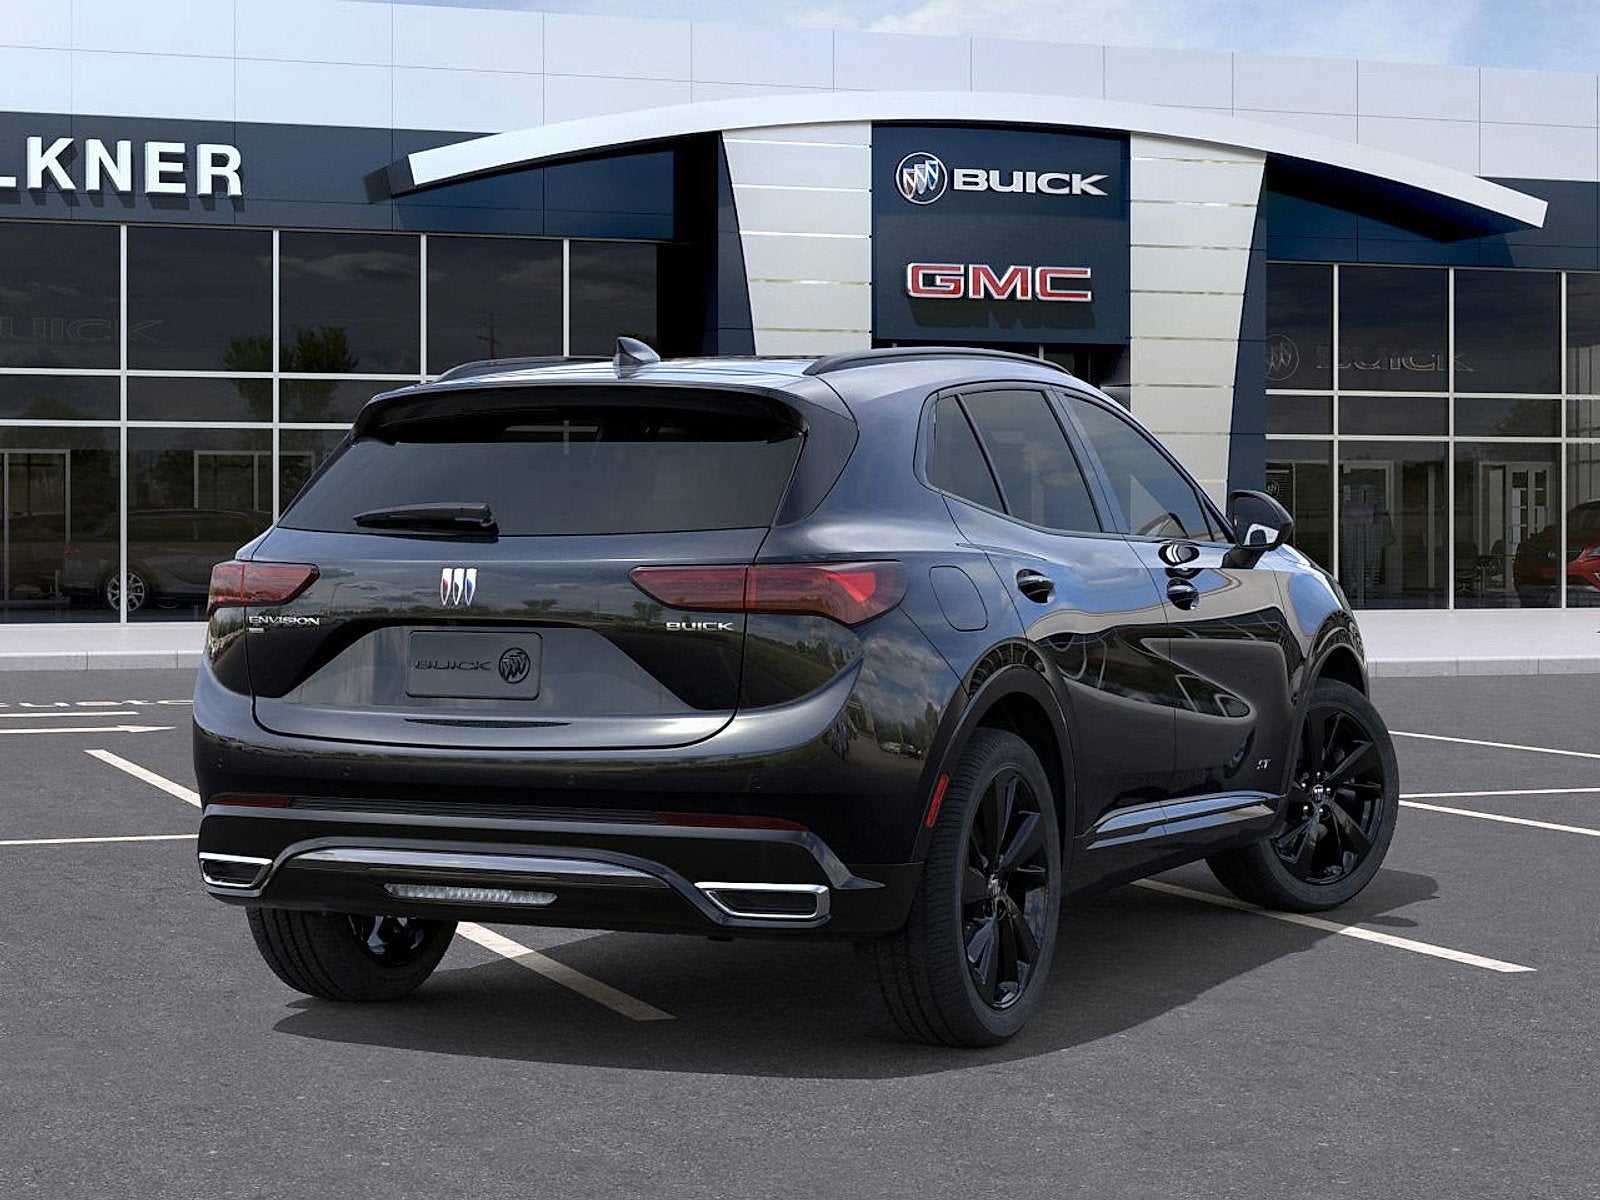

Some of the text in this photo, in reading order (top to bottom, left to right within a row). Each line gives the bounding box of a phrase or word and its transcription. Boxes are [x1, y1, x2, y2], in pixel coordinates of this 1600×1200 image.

[954, 168, 1109, 196] BUICK
[907, 263, 1092, 302] GMC
[248, 616, 320, 626] ENVISION
[666, 622, 735, 631] BUICK
[413, 660, 492, 672] BUICK
